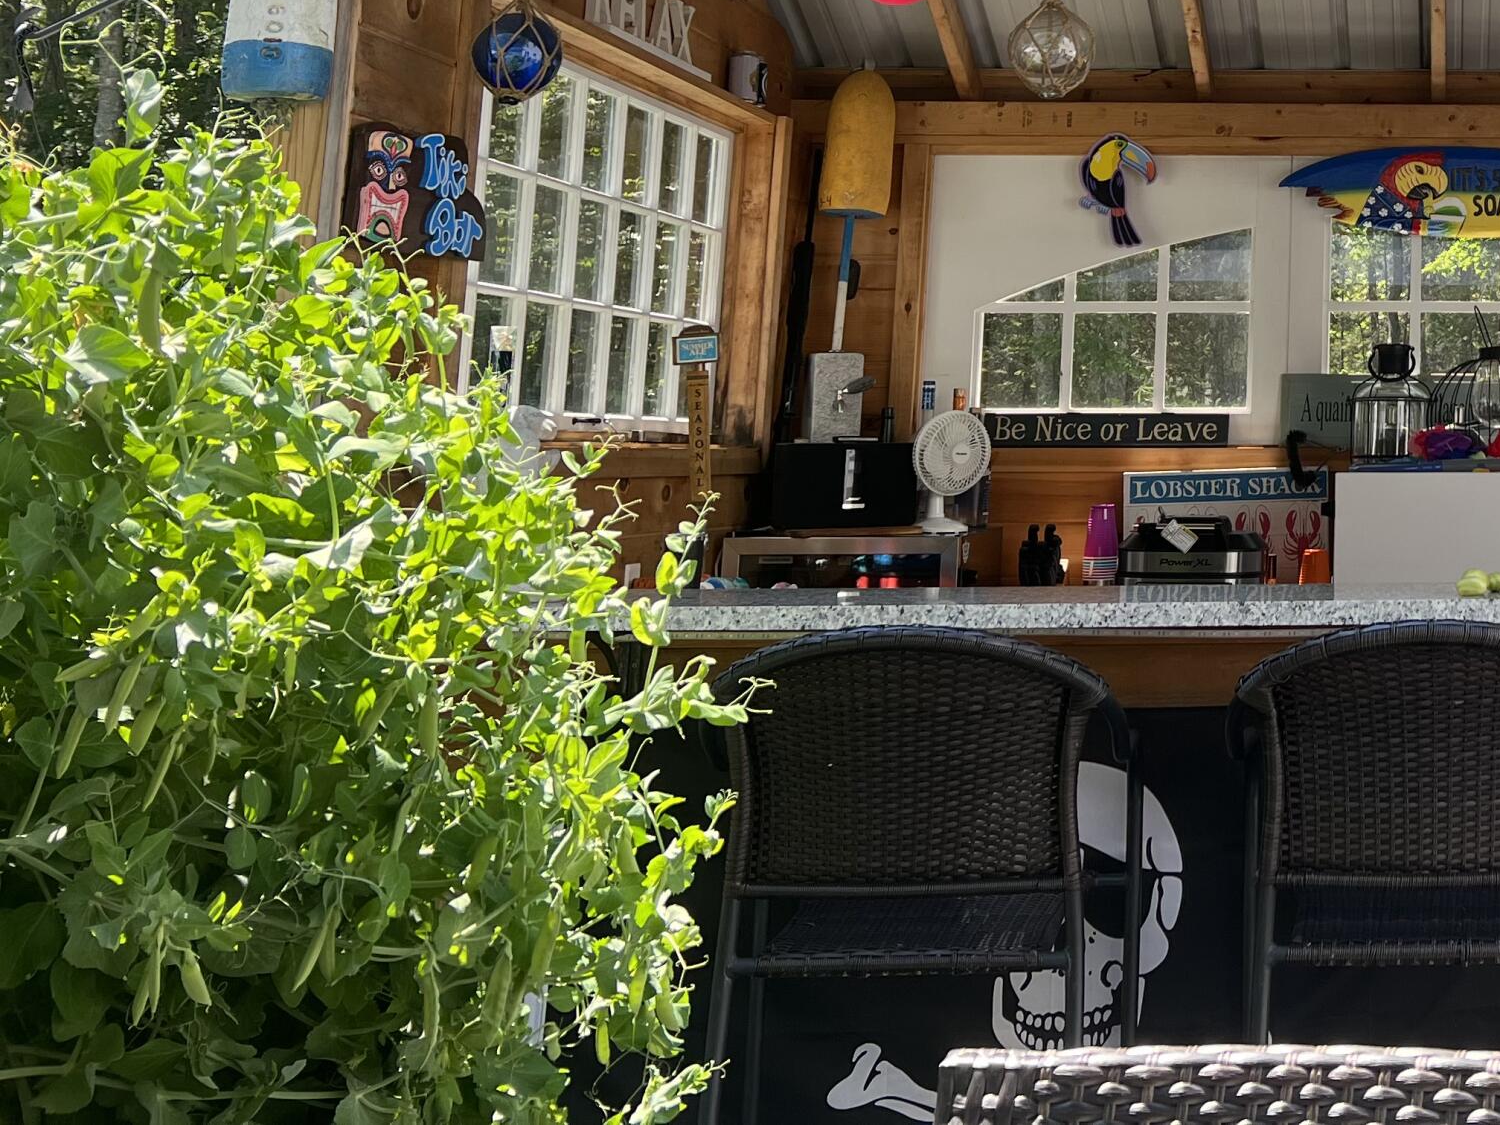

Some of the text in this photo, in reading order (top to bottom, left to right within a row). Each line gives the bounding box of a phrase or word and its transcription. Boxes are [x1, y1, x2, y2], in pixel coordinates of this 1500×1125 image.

[420, 133, 469, 200] Tiki
[429, 197, 483, 258] Bar
[993, 415, 1218, 442] Be Nice or Leave
[1301, 393, 1312, 423] A
[1315, 392, 1352, 431] quain
[694, 388, 705, 487] SEASONAL
[1133, 477, 1242, 499] LOBSTER
